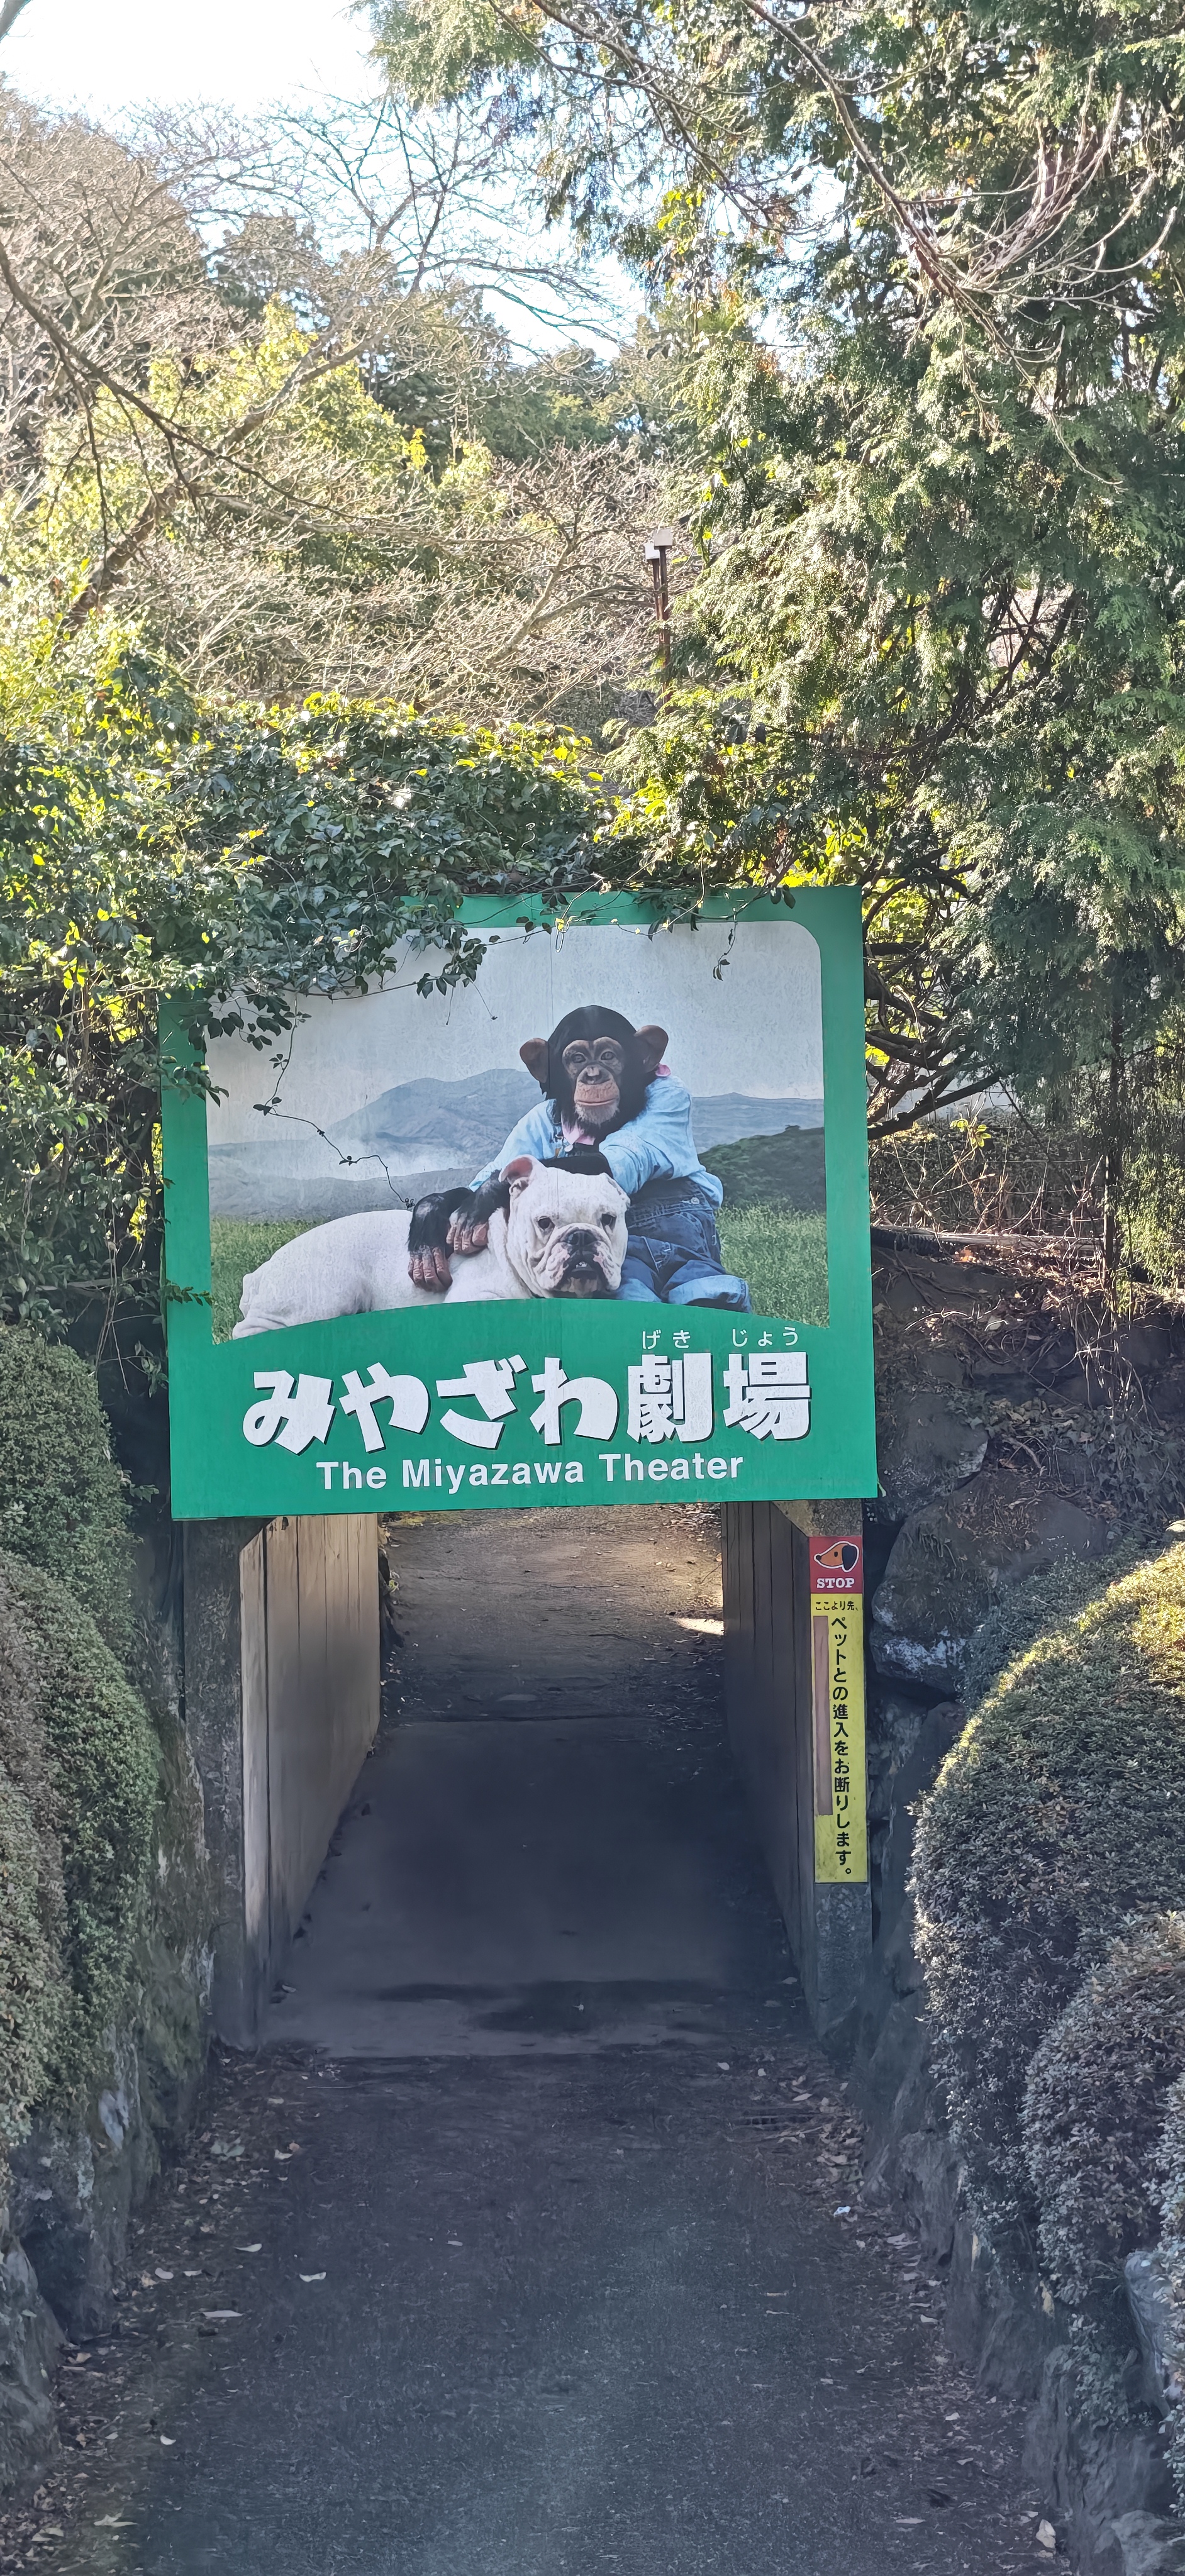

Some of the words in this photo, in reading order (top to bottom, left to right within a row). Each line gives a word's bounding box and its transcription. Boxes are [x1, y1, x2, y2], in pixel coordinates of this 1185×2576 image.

[642, 1330, 691, 1350] げき
[732, 1326, 799, 1347] じょう
[243, 1352, 811, 1455] みやざわ劇場
[316, 1461, 387, 1490] The
[401, 1458, 584, 1494] Miyazawa
[598, 1453, 744, 1482] Theater
[816, 1577, 855, 1588] STOP
[831, 1616, 851, 1875] ペットとの進入をお断りします。
